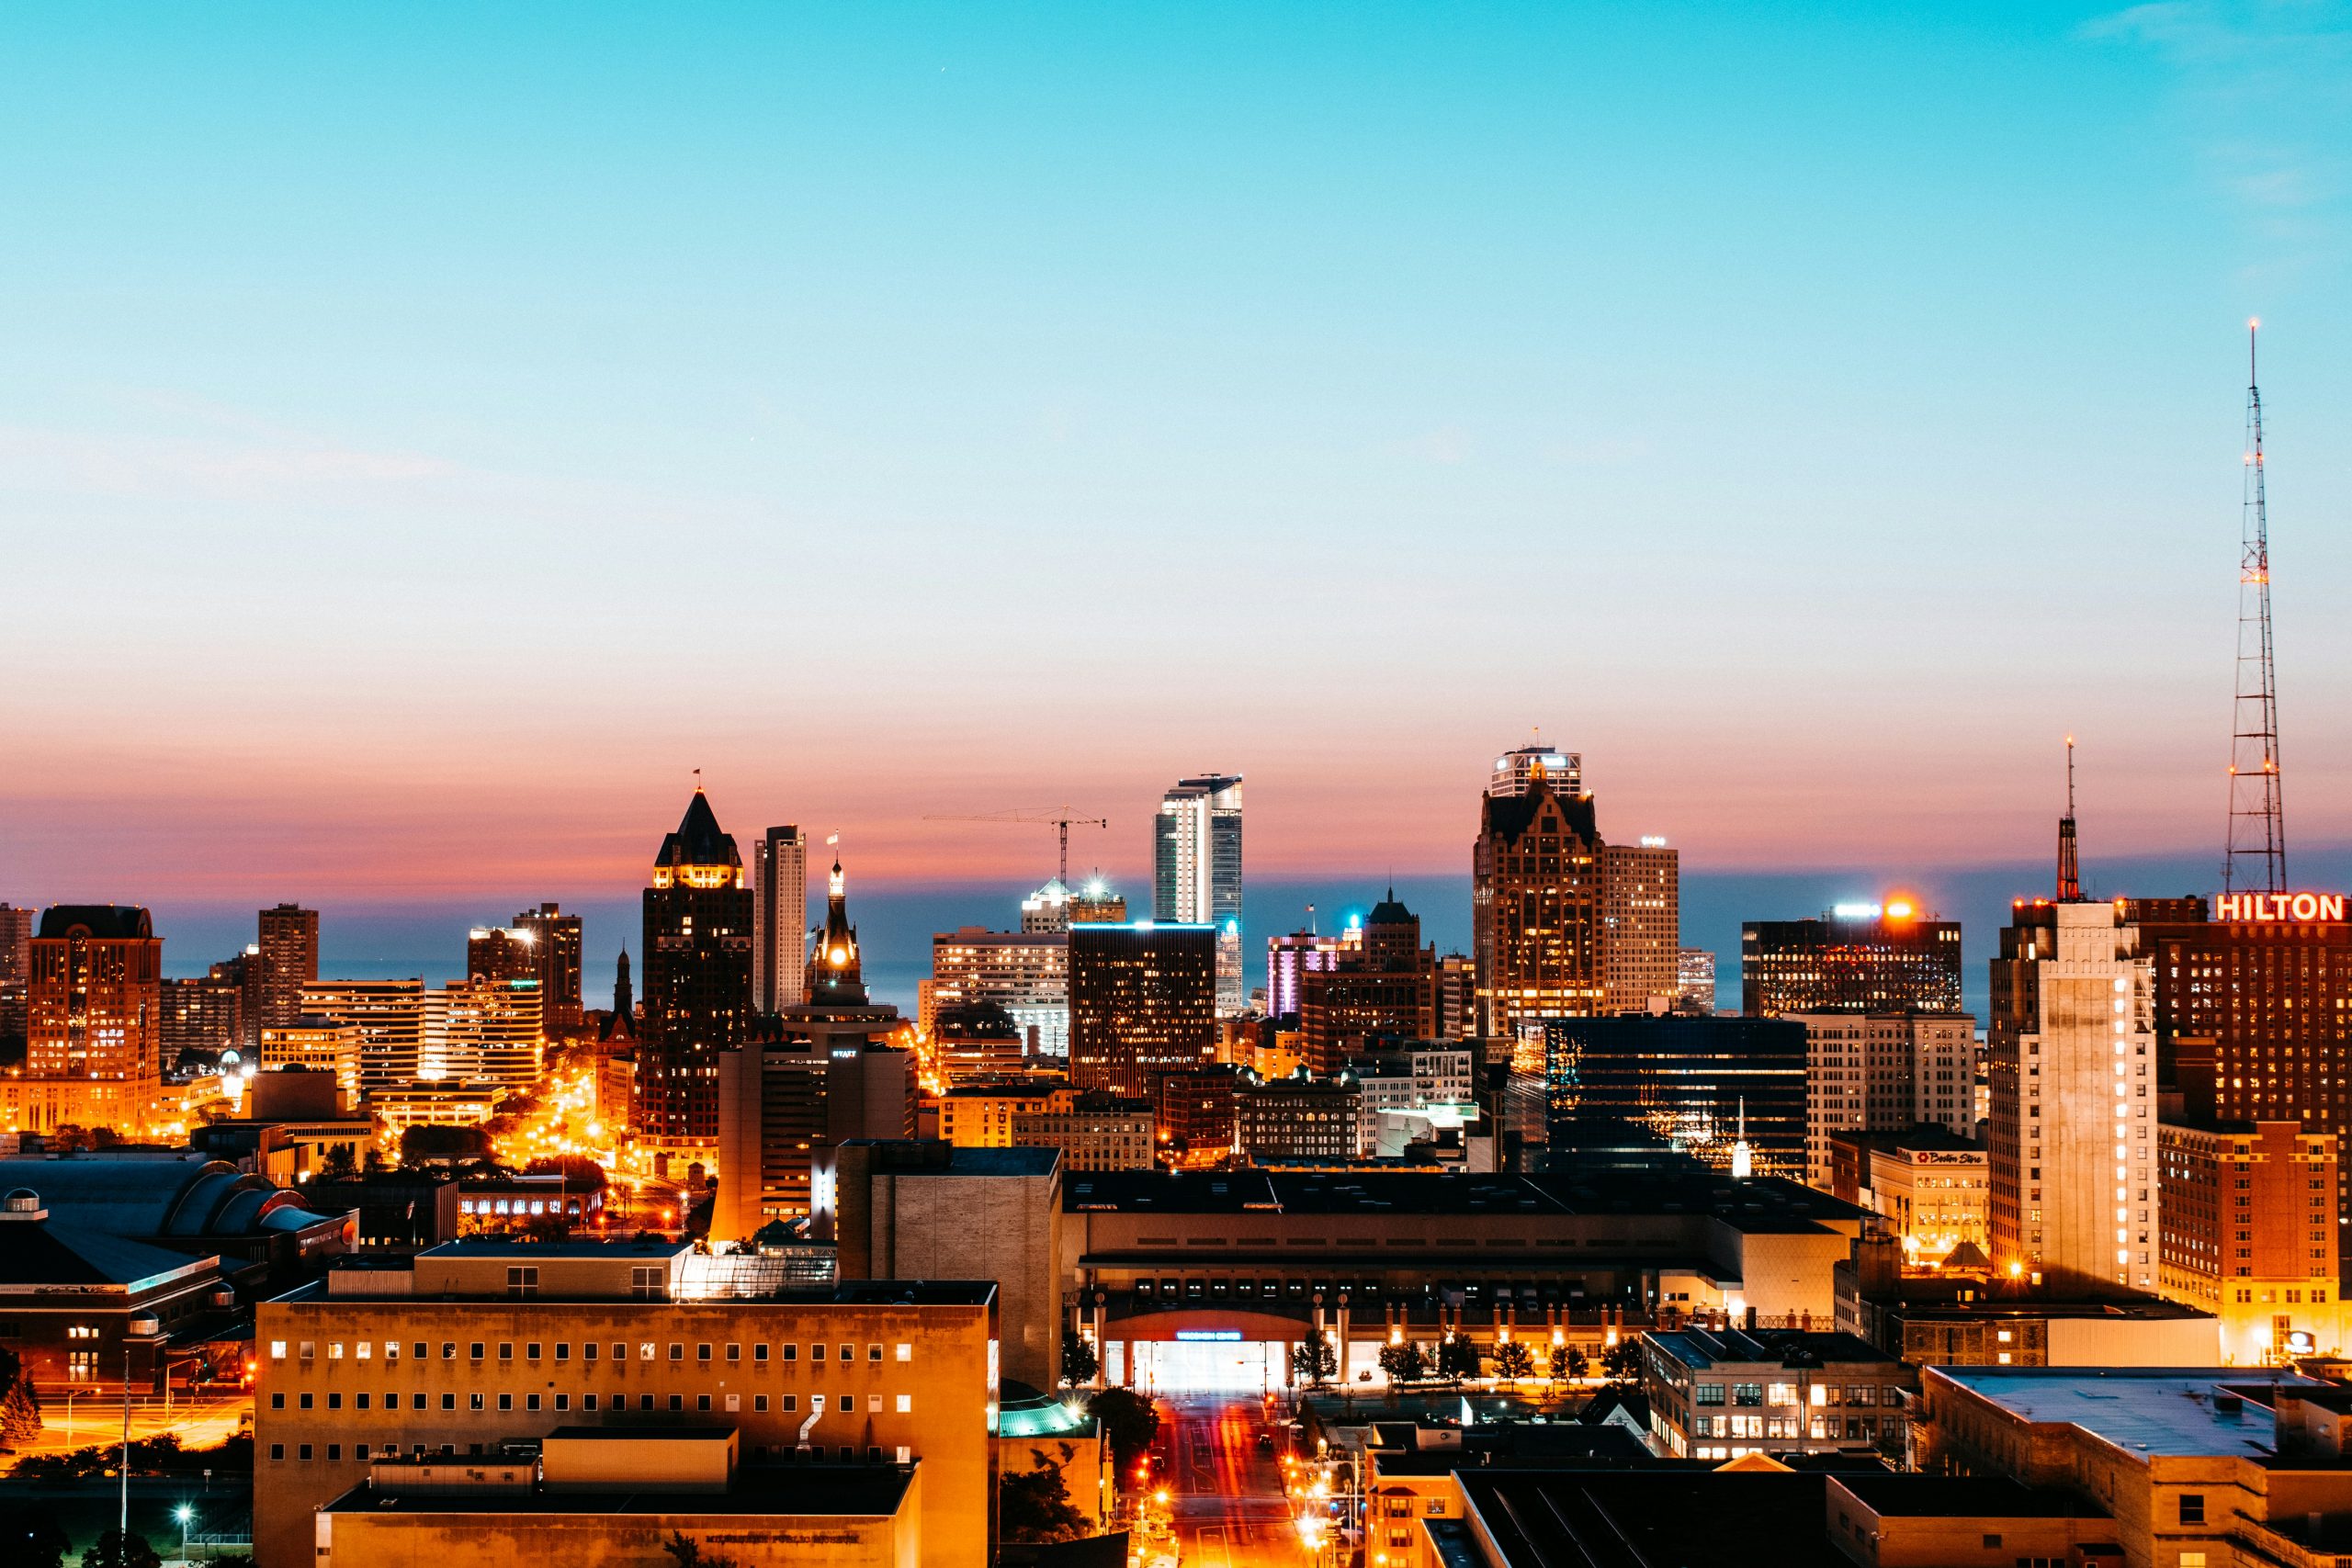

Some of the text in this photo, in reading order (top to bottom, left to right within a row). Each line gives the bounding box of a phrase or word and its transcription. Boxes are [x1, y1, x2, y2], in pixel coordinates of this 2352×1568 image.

[2217, 894, 2343, 920] HILTON
[1929, 1152, 1983, 1164] Boston Store
